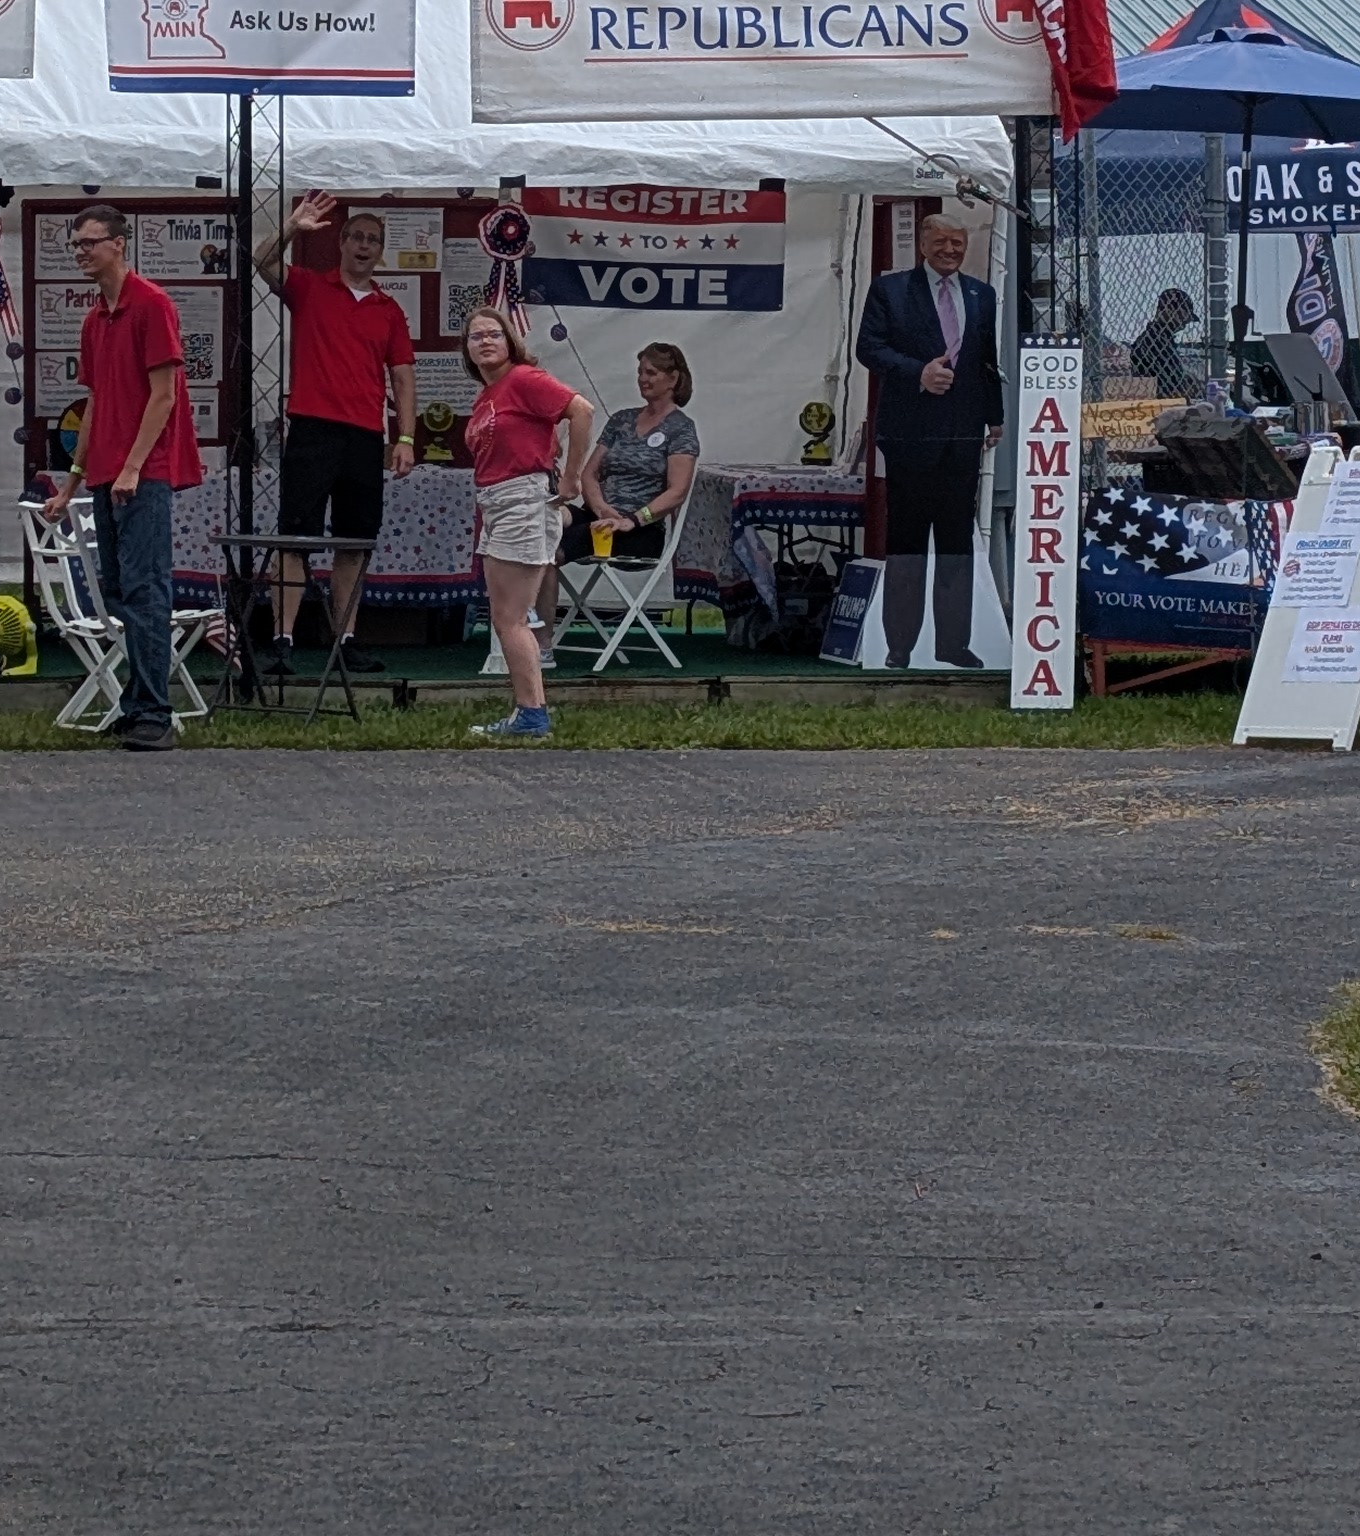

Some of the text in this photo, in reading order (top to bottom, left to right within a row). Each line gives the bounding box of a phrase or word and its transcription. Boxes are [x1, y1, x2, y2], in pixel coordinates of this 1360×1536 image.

[153, 21, 196, 38] MIN
[229, 10, 376, 33] Ask Us How!
[589, 2, 970, 51] REPUBLICANS
[1225, 162, 1304, 202] OAK
[1317, 165, 1333, 194] &
[558, 187, 748, 216] REGISTER
[166, 219, 201, 241] Trivia
[639, 234, 669, 250] TO
[577, 265, 729, 306] VOTE
[1024, 355, 1079, 373] GOD
[1023, 375, 1079, 391] BLESS
[1022, 397, 1071, 696] AMERICA
[1094, 590, 1146, 610] YOUR
[1148, 594, 1196, 613] VOTE
